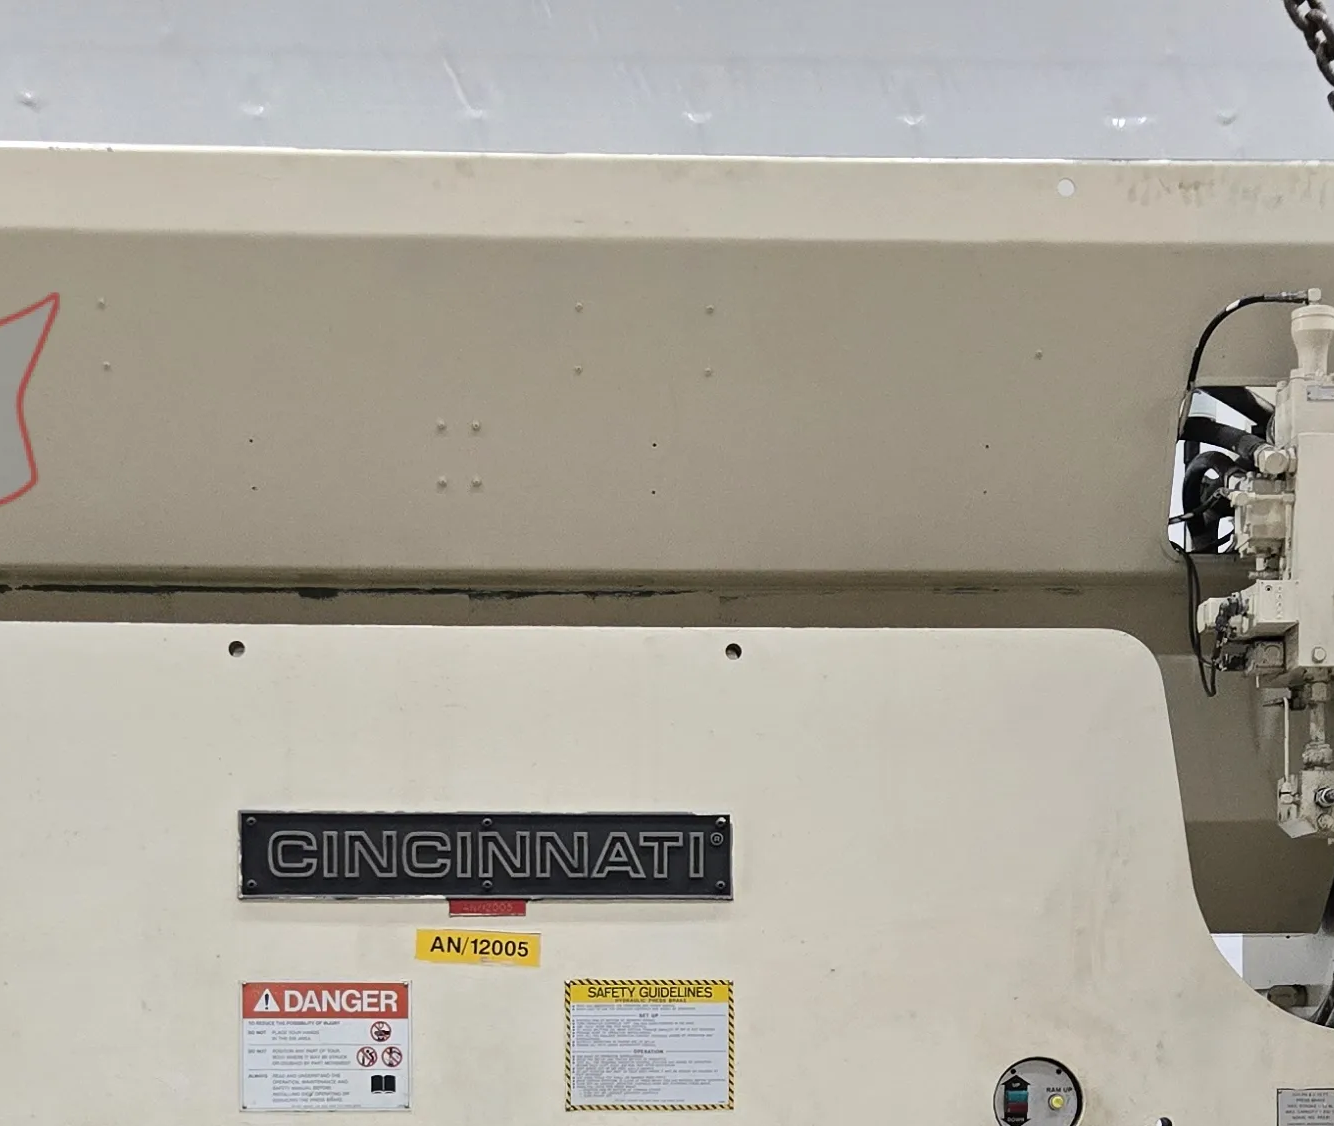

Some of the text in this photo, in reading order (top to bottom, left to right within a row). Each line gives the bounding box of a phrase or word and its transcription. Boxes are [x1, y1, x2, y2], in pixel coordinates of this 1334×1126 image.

[267, 830, 705, 879] CINCINNATI
[430, 936, 529, 957] AN/12005
[284, 989, 399, 1013] DANGER
[587, 986, 713, 999] SAFETY GUIDELINES
